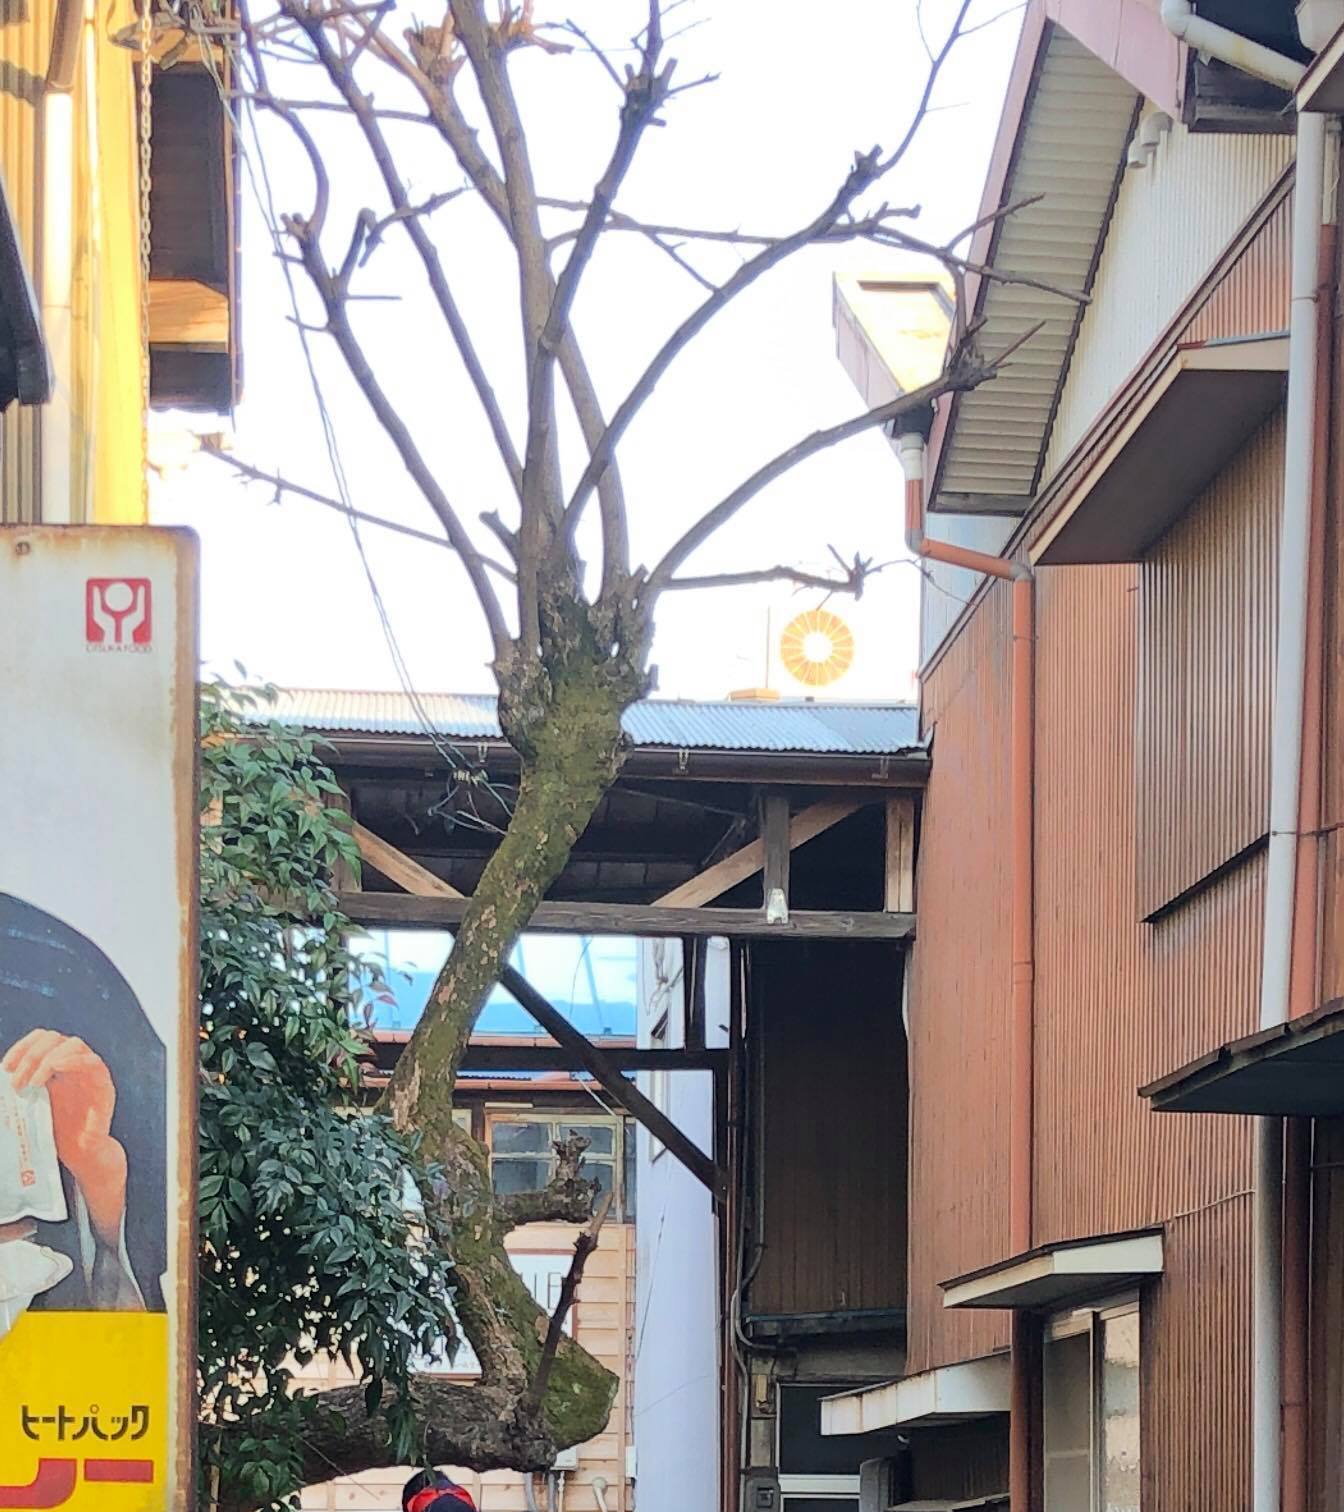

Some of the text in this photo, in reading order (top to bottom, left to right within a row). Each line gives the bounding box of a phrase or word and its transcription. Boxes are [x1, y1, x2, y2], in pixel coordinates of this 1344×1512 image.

[21, 1404, 150, 1441] ヒートパック
